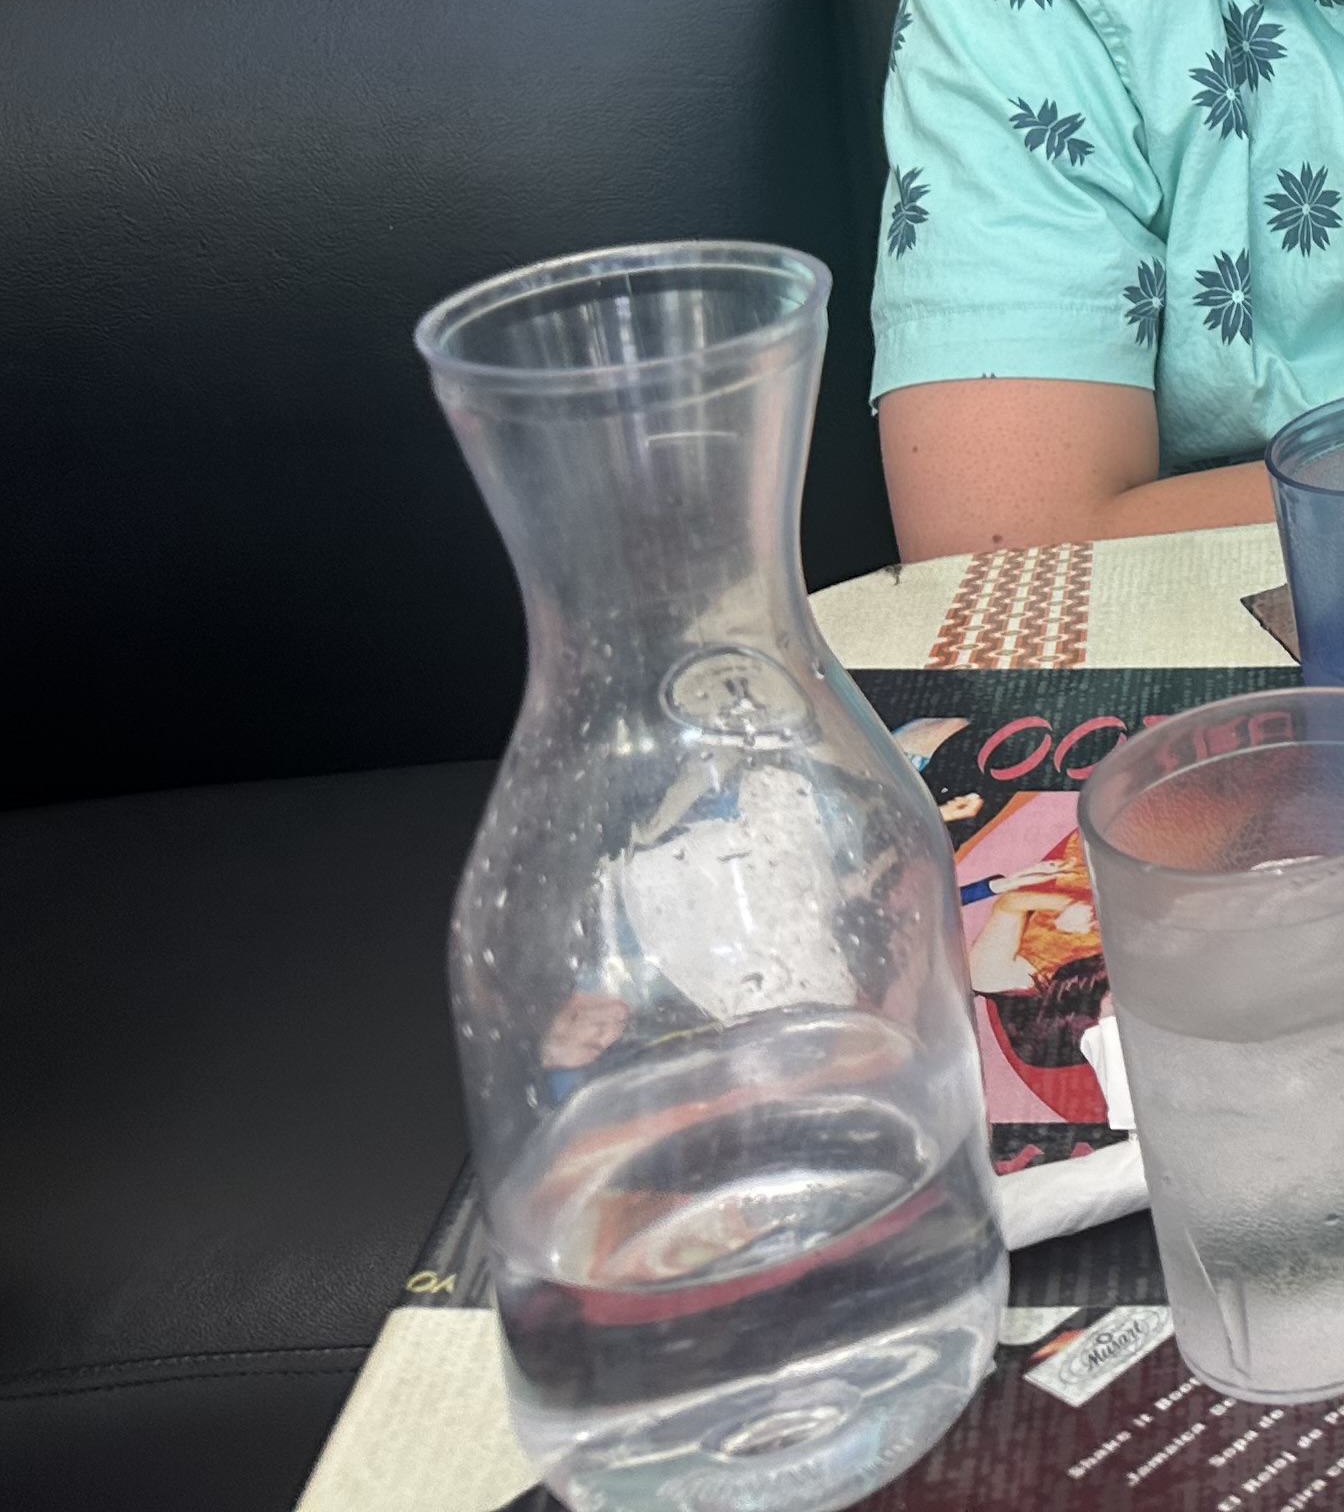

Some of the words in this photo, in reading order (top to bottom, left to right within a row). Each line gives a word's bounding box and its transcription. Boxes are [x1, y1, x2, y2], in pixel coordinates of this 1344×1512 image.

[1083, 1320, 1144, 1372] Musart
[1068, 1431, 1131, 1478] Shake
[1127, 1422, 1206, 1486] Jamaica
[1208, 1430, 1259, 1467] Sopa
[1242, 1451, 1297, 1493] Reloj
